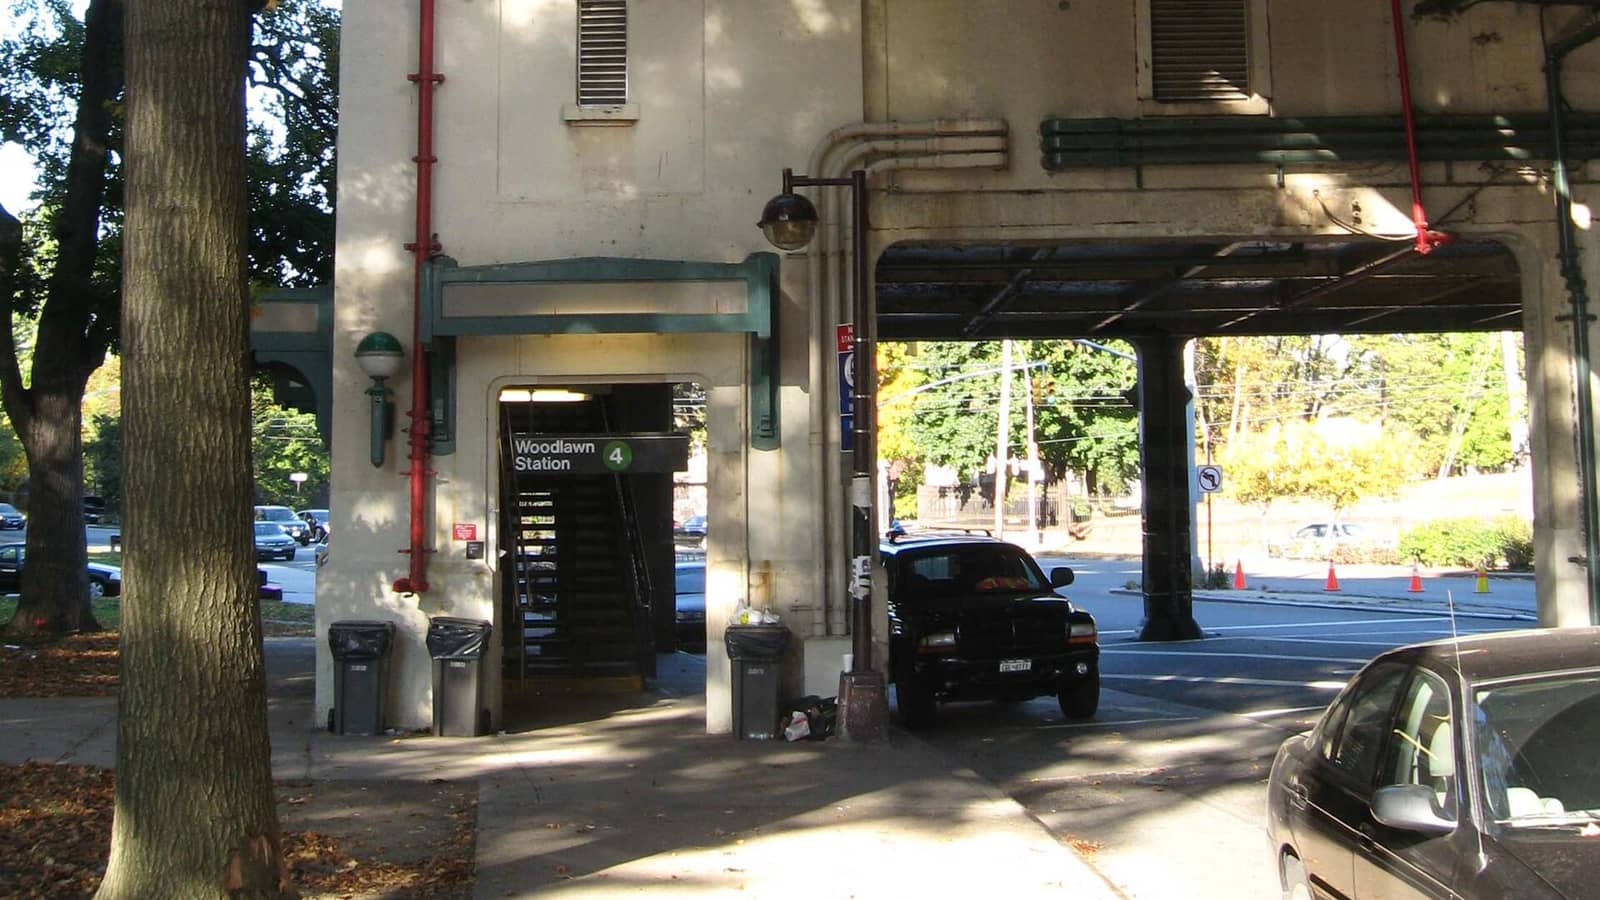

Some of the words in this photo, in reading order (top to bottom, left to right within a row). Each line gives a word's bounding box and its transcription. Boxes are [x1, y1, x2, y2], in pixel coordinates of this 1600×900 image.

[515, 440, 595, 454] Woodlawn
[609, 447, 623, 464] 4
[515, 456, 571, 471] Station
